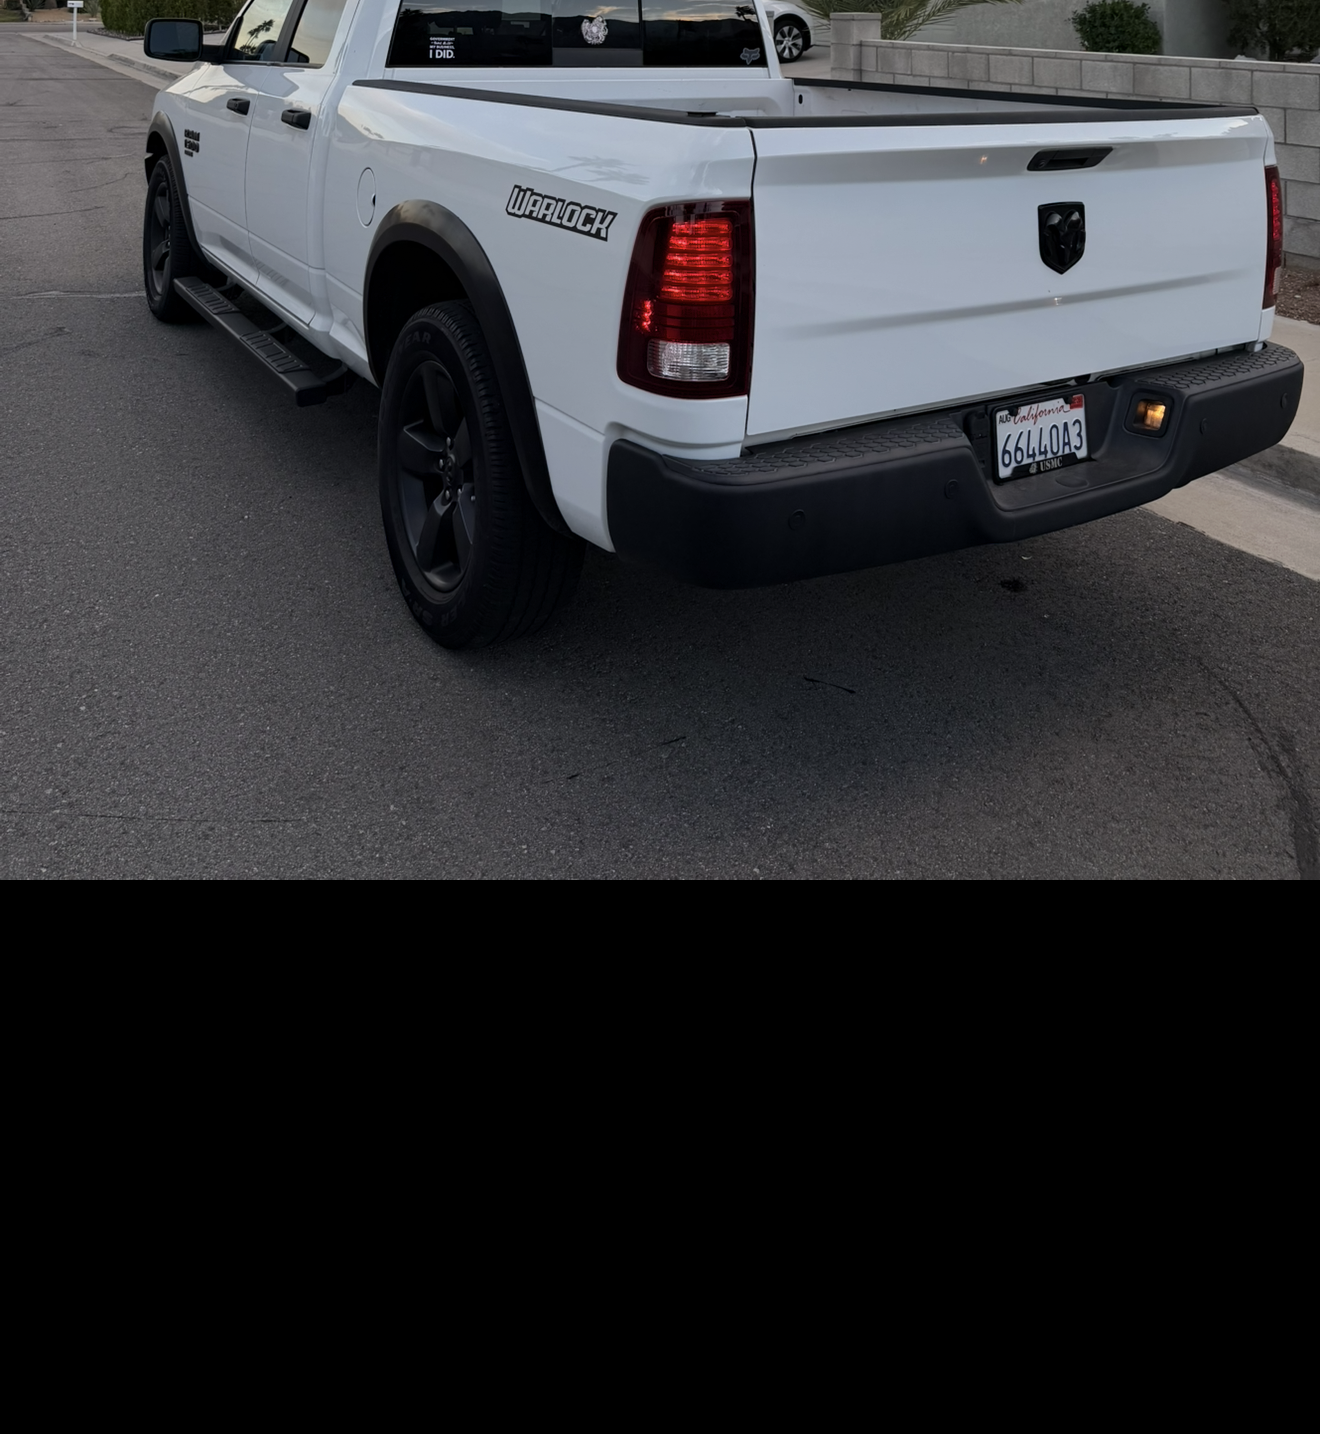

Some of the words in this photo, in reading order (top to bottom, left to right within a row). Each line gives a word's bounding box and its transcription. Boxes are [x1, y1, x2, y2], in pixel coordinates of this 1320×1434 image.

[429, 49, 433, 59] I
[435, 49, 455, 59] DID.
[506, 184, 618, 242] WARLOCK
[999, 413, 1011, 424] AUG
[1012, 400, 1071, 426] California
[1001, 418, 1084, 468] 66440A3
[1040, 456, 1063, 472] USMC
